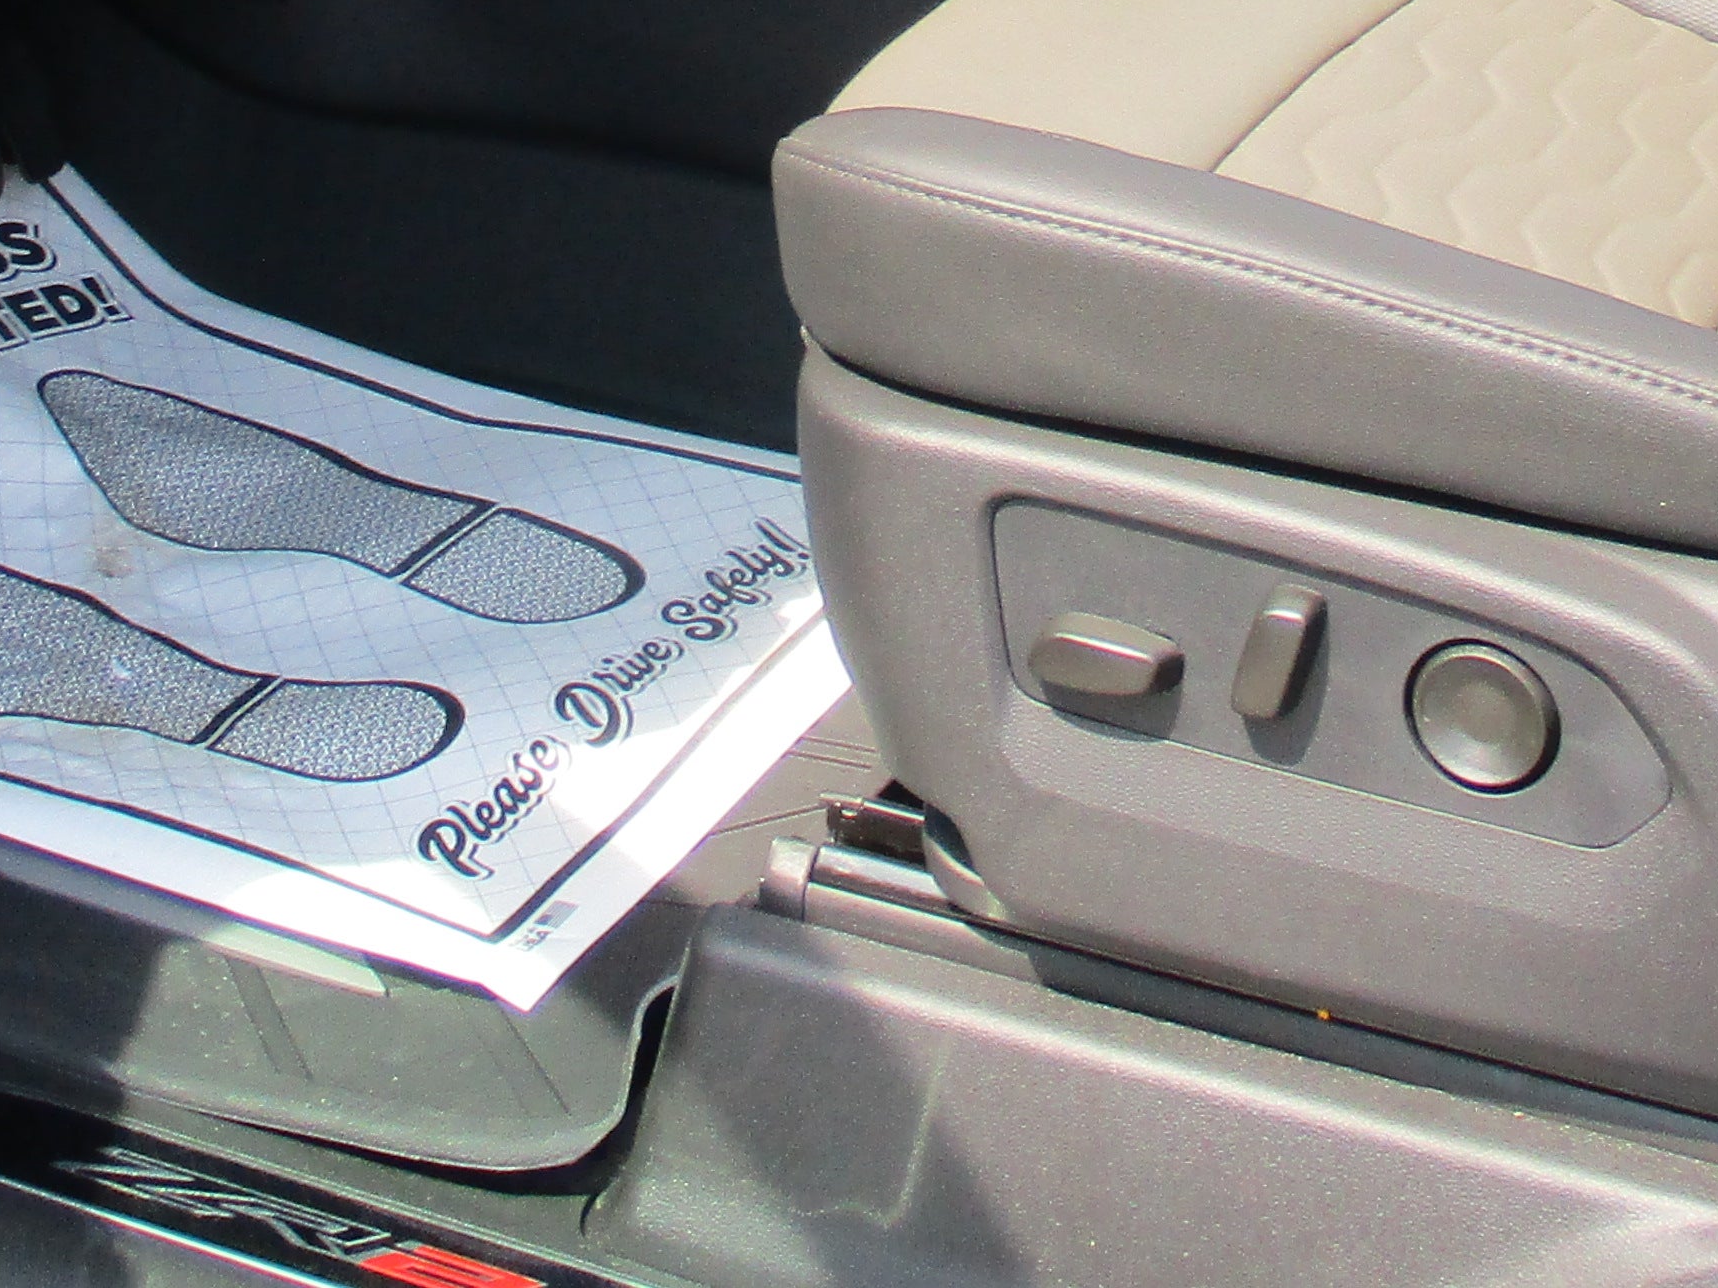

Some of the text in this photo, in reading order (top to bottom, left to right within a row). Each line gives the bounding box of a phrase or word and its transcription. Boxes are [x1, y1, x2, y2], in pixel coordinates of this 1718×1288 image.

[417, 518, 813, 878] Please Drive Safely!
